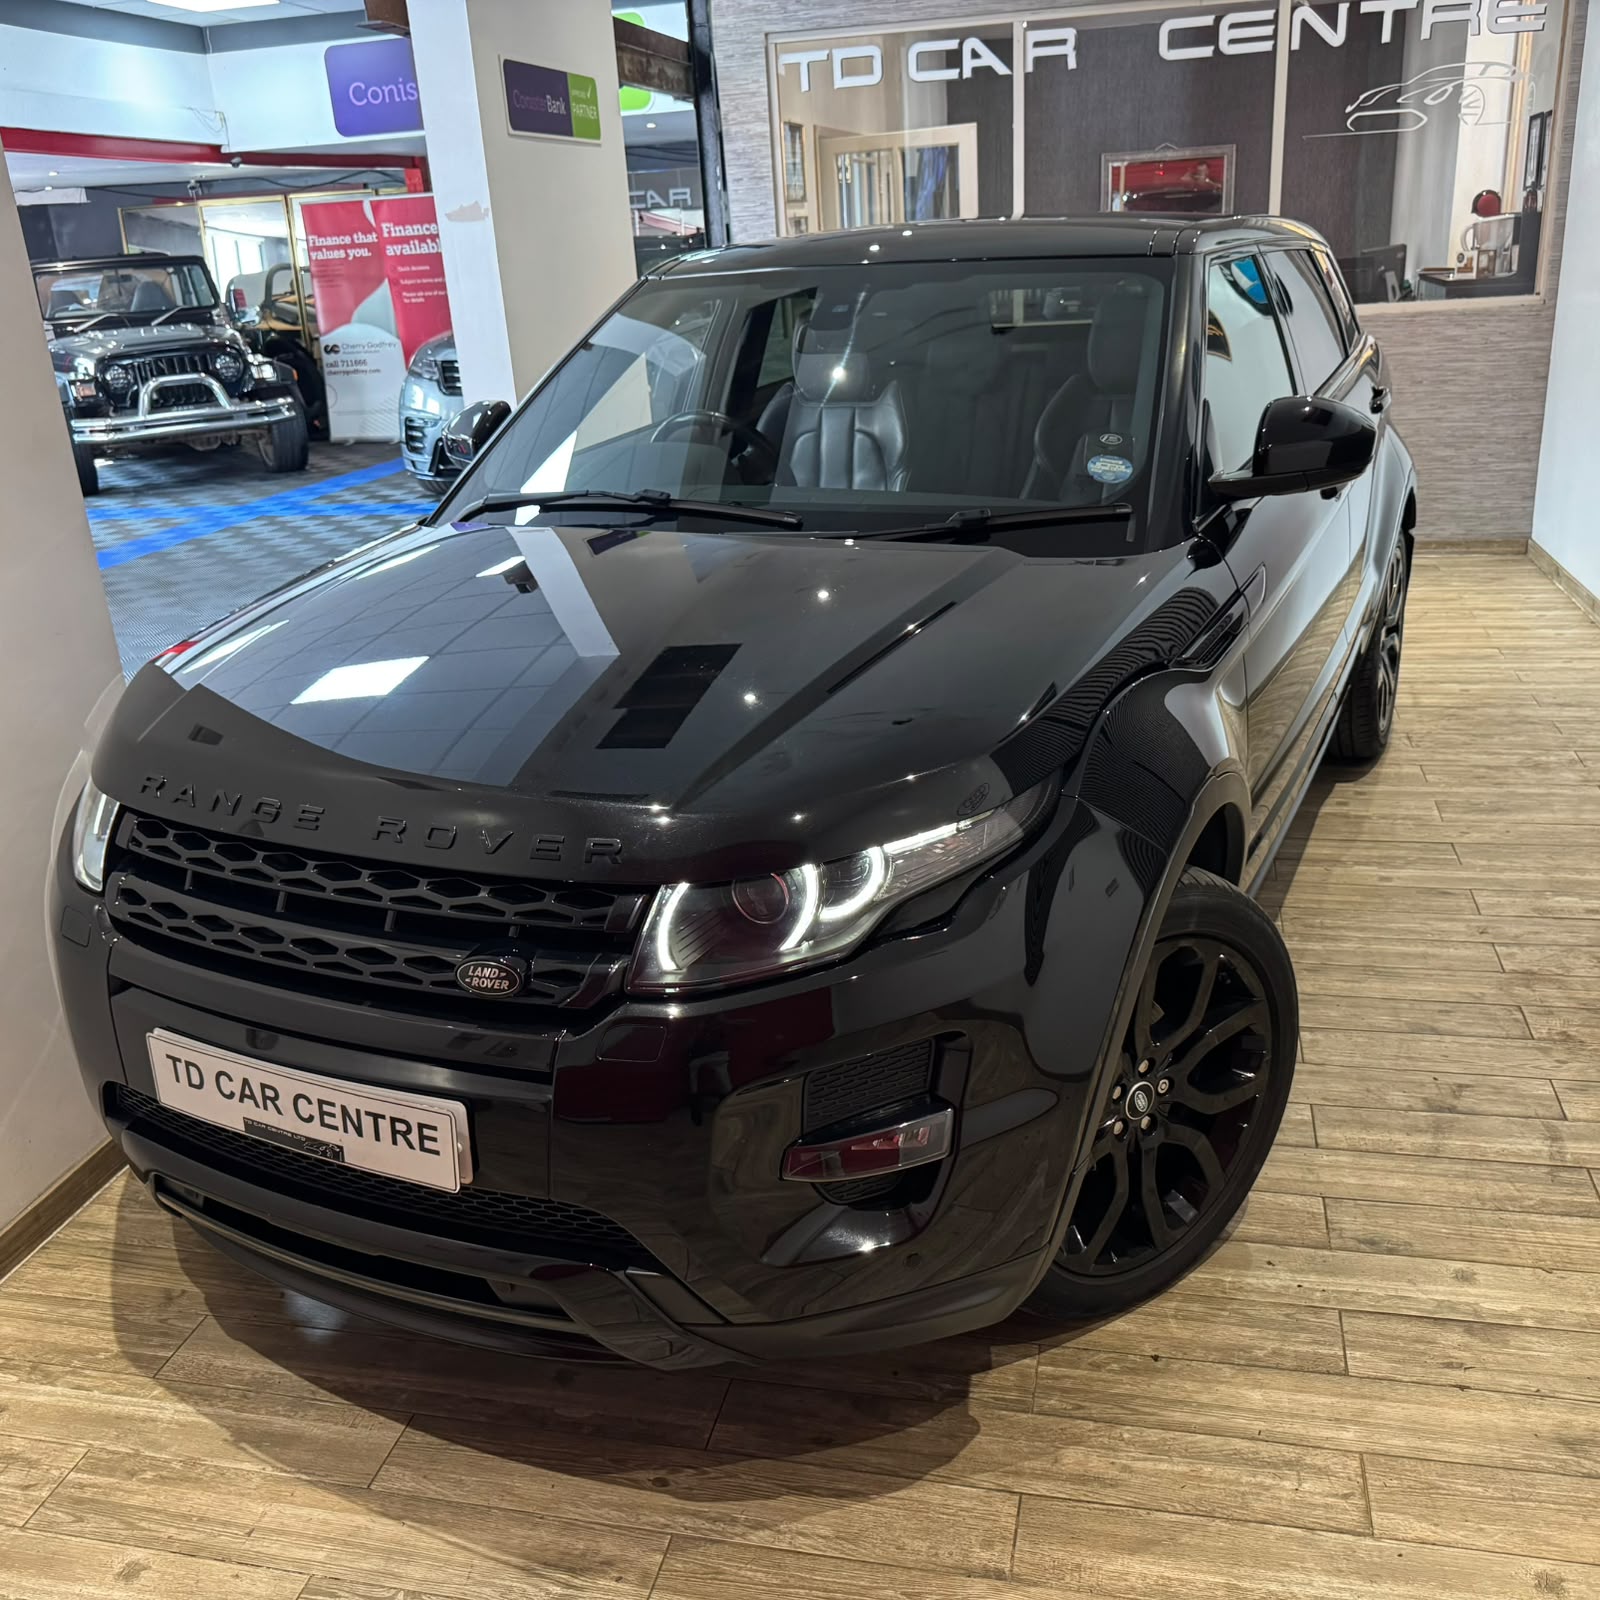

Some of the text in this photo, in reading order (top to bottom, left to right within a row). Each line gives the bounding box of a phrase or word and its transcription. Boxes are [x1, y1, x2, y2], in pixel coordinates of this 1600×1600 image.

[778, 0, 1548, 93] TD CAR CENTRE
[348, 77, 418, 106] Conis
[381, 222, 438, 238] Finance
[308, 231, 378, 247] Finance that
[310, 247, 372, 260] values you.
[341, 343, 365, 351] Cherry
[326, 360, 339, 368] call
[138, 774, 623, 866] RANGE ROVER
[468, 965, 500, 979] LAND
[471, 977, 510, 990] ROVER
[165, 1053, 441, 1157] TD CAR CENTRE
